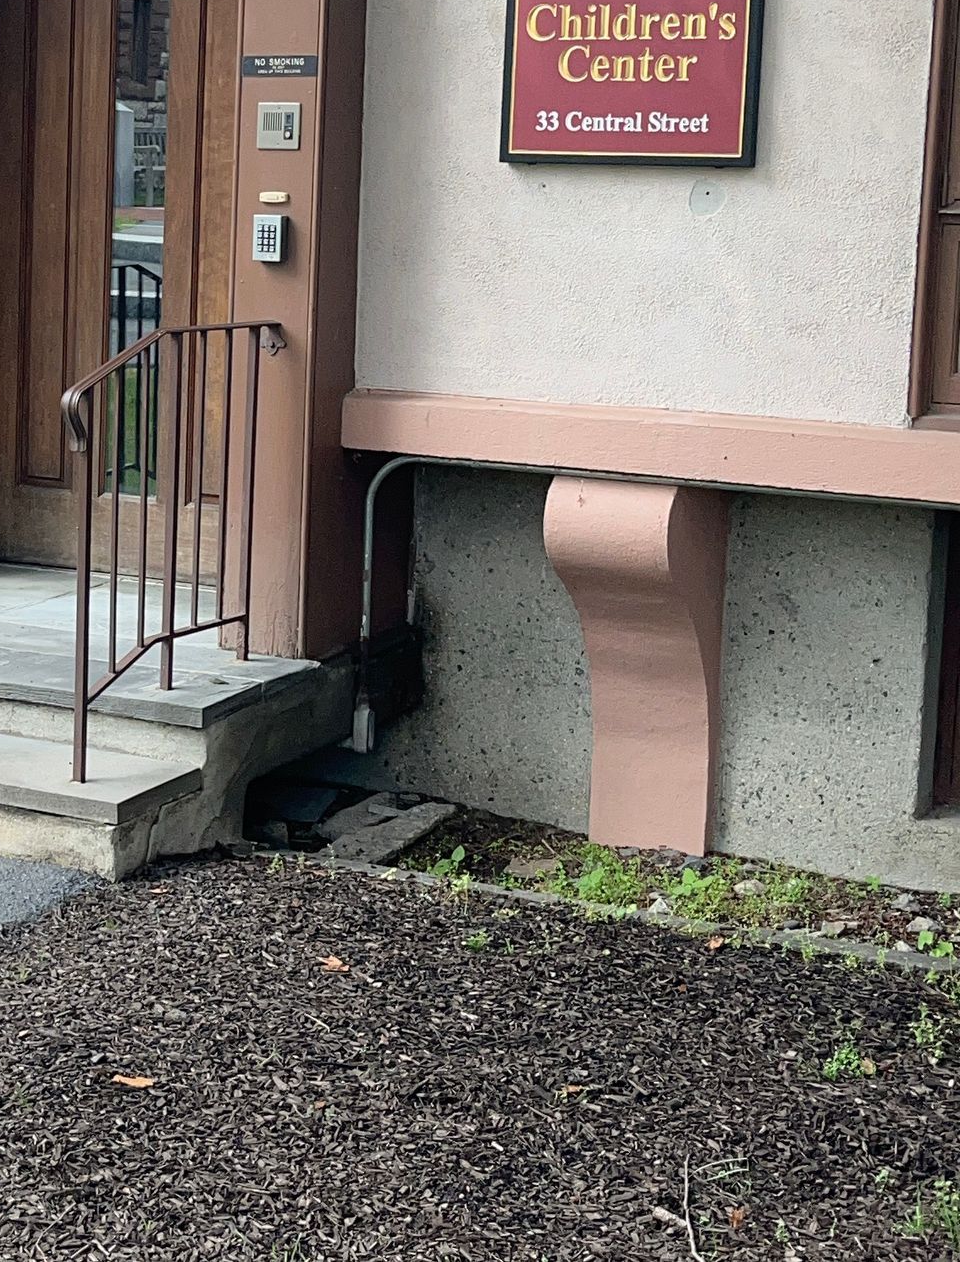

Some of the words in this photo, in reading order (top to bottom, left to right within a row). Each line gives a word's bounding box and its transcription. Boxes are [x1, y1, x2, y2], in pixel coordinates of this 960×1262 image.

[526, 2, 736, 41] Children's
[254, 58, 266, 66] NO
[268, 58, 305, 66] SMOKING
[558, 45, 697, 83] Center
[535, 111, 559, 131] 33
[565, 111, 642, 132] Central
[647, 112, 709, 133] Street
